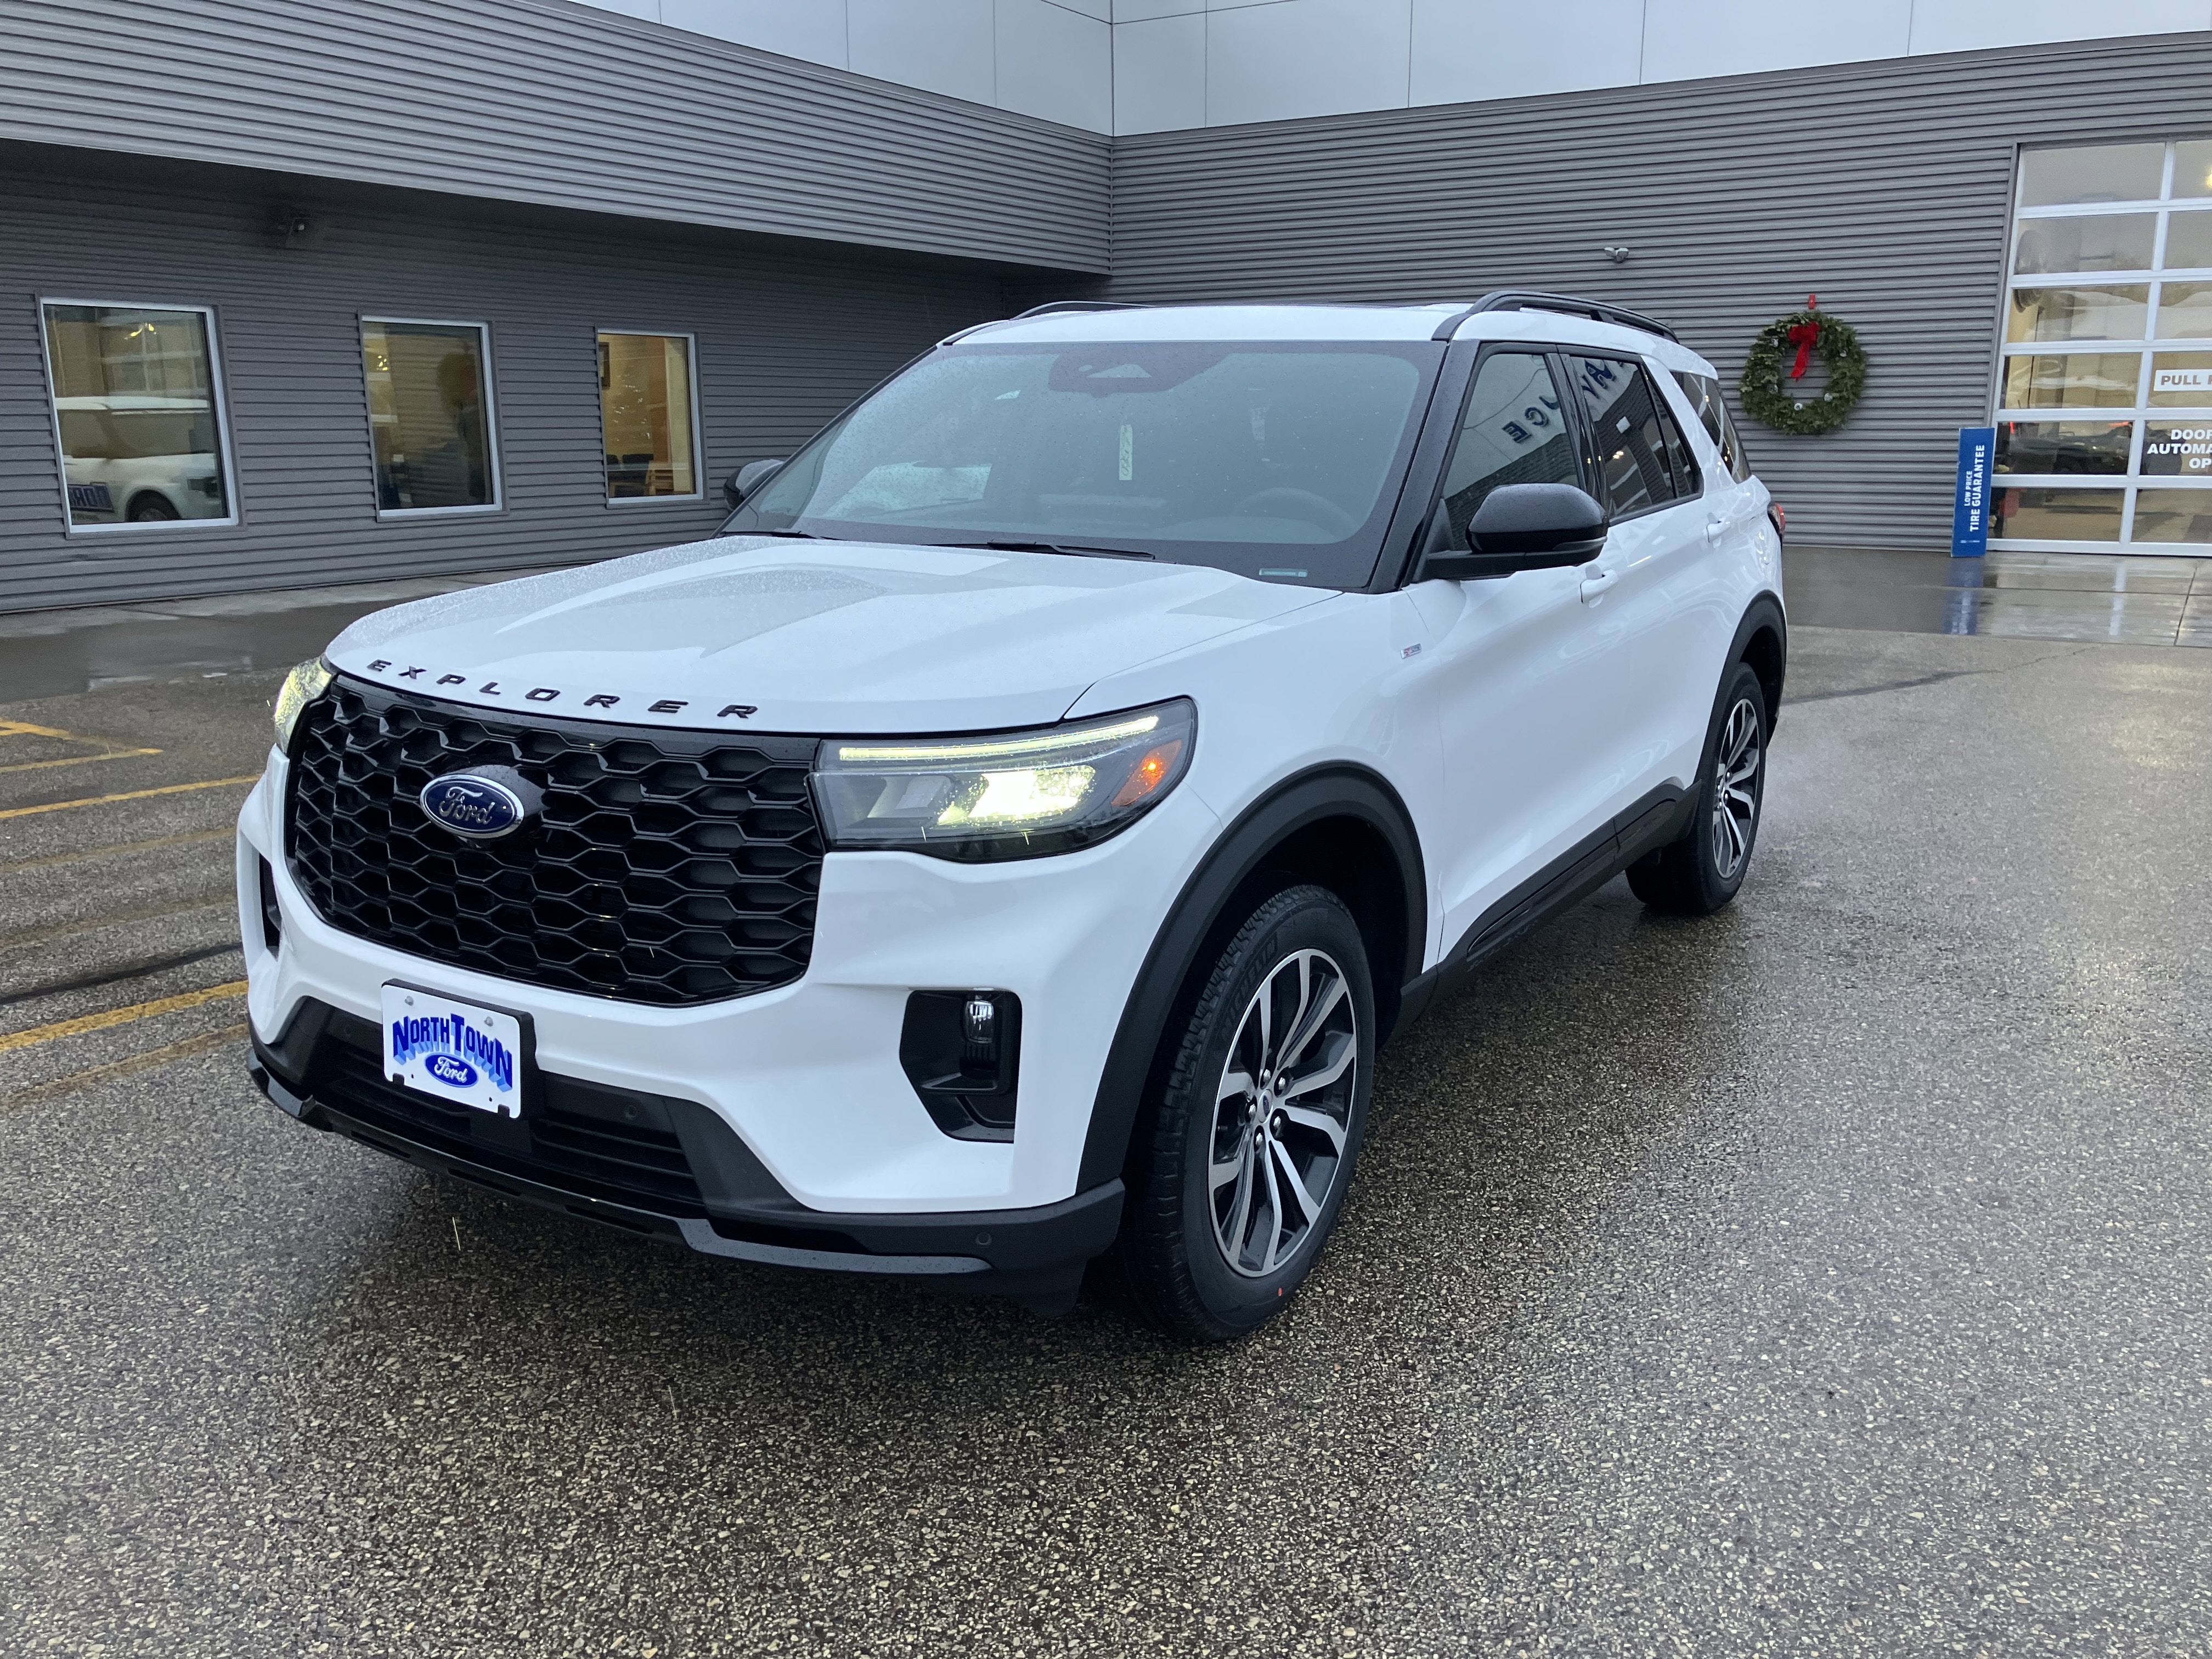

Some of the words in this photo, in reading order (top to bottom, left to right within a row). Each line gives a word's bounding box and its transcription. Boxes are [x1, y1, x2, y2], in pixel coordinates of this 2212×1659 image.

[2161, 375, 2201, 385] PULL
[1971, 445, 1985, 507] GUARANTEE
[1970, 509, 1980, 532] TIRE
[366, 659, 758, 719] EXPLORER
[438, 786, 496, 826] Ford
[434, 1056, 468, 1083] Ford
